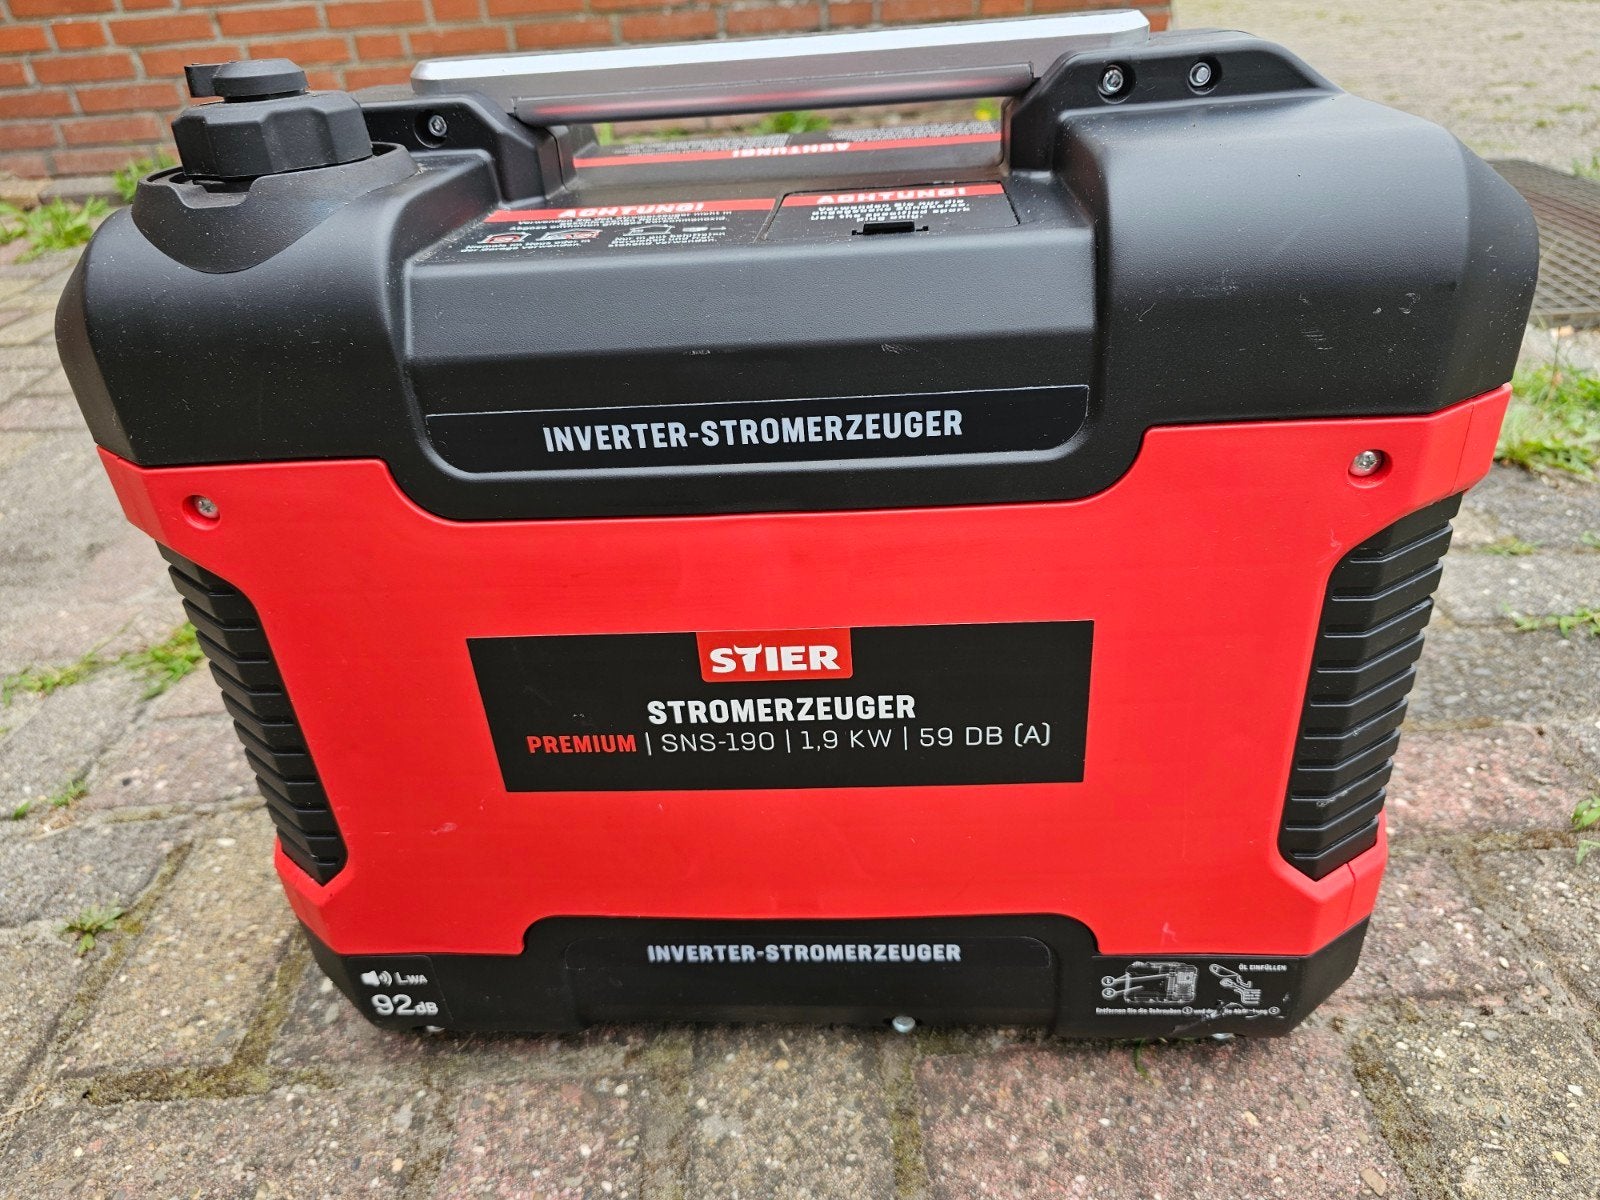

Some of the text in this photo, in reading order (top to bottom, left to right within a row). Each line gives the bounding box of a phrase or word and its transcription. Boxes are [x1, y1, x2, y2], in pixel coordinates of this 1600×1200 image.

[558, 203, 705, 218] ACHTUNG!
[817, 187, 966, 204] ACHTUNG!
[543, 409, 964, 453] INVERTER-STROMERZEUGER
[709, 643, 840, 675] STIER
[647, 694, 916, 726] STROMERZEUGER
[526, 722, 1051, 755] PREMIUM SNS-190 1,9 KW 59 DB (A)
[646, 943, 962, 963] INVERTER-STROMERZEUGER
